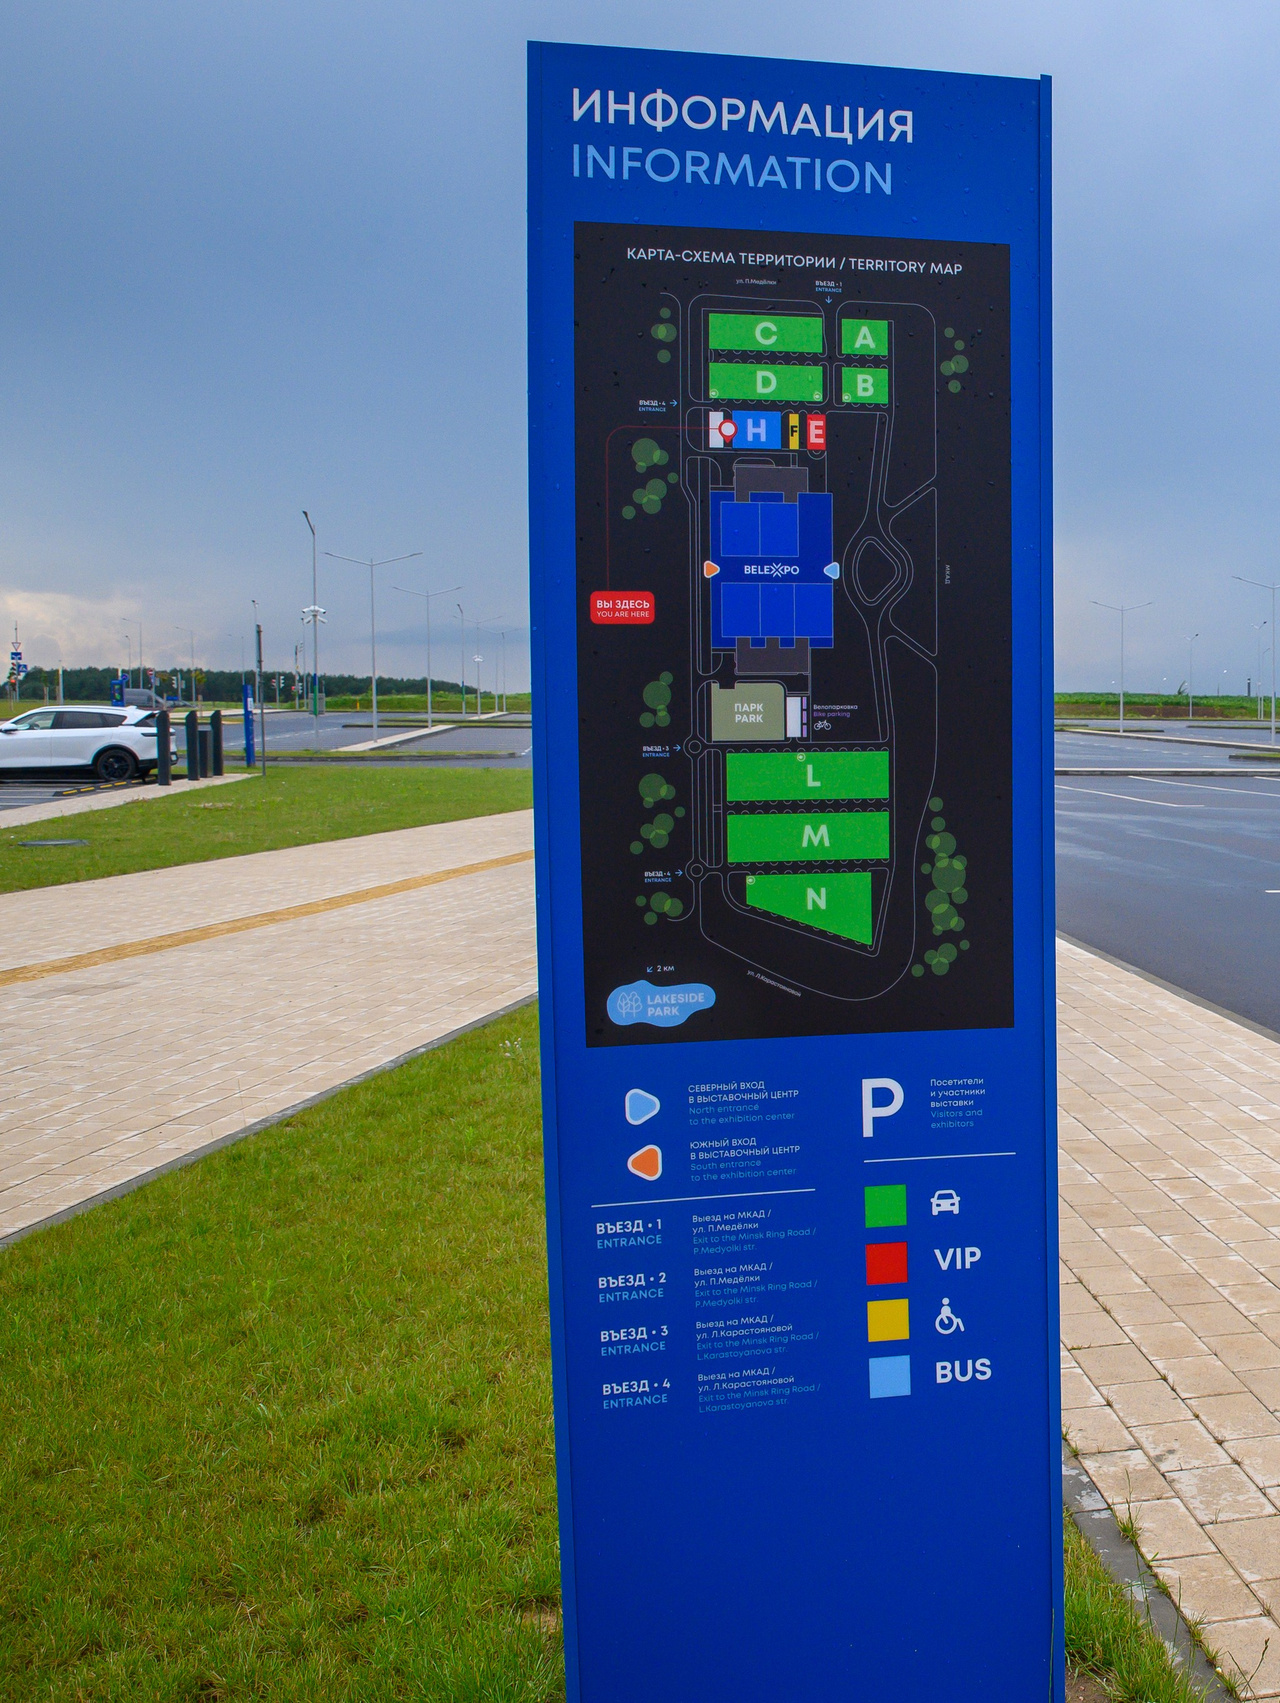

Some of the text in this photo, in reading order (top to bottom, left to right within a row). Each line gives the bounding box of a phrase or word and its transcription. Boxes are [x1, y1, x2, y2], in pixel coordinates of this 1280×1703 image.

[572, 88, 913, 144] ИНФОРМАЦИЯ
[572, 143, 892, 195] INFORMATION
[627, 247, 735, 264] КАРТА-СХЕМА
[739, 252, 836, 269] ТЕРРИТОРИИ
[849, 258, 926, 274] TERRITORY
[930, 262, 963, 275] MAP
[754, 322, 778, 346] C
[854, 325, 876, 349] A
[756, 370, 777, 394] D
[857, 374, 874, 397] B
[747, 419, 766, 442] H
[790, 425, 797, 437] F
[810, 421, 824, 443] E
[596, 600, 650, 609] ВЫ ЗДЕСЬ
[734, 703, 764, 712] ПАРК
[735, 714, 764, 723] PARK
[807, 765, 821, 787] L
[802, 825, 830, 847] M
[807, 887, 826, 910] N
[647, 992, 705, 1005] LAKESIDE
[649, 1006, 679, 1016] PARK
[688, 1081, 765, 1093] СЕВЕРНЫЙ ВХОД
[930, 1078, 984, 1087] Посетители
[688, 1090, 799, 1104] В ВЫСТАВОЧНЫЙ ЦЕНТР
[938, 1088, 986, 1098] участники
[689, 1104, 759, 1115] North entrance
[862, 1077, 904, 1138] P
[930, 1100, 974, 1108] выставки
[689, 1112, 795, 1126] to the exhibition center
[930, 1110, 963, 1118] Visitors
[931, 1120, 974, 1129] exhibitors
[690, 1138, 757, 1149] ЮЖНЫЙ ВХОД
[690, 1145, 800, 1160] В ВЫСТАВОЧНЫЙ ЦЕНТР
[690, 1160, 761, 1171] South entrance
[691, 1168, 796, 1182] to the exhibition center
[692, 1214, 721, 1223] Выезд
[737, 1210, 765, 1219] МКАД
[596, 1219, 661, 1235] ВЪЕЗД 1
[692, 1222, 758, 1235] ул. П.Медёлки
[597, 1234, 662, 1249] ENTRANCE
[693, 1236, 708, 1245] Exit
[710, 1235, 720, 1243] to
[721, 1234, 736, 1242] the
[738, 1232, 764, 1241] Minsk
[766, 1230, 785, 1239] Ring
[787, 1228, 810, 1237] Road
[693, 1244, 741, 1255] P.Medyolki
[933, 1246, 982, 1271] VIP
[694, 1267, 723, 1276] Выезд
[739, 1263, 767, 1272] МКАД
[598, 1272, 666, 1289] ВЪЕЗД 2
[694, 1275, 760, 1288] ул. П.Медёлки
[599, 1288, 664, 1303] ENTRANCE
[695, 1289, 710, 1298] Exit
[712, 1288, 721, 1296] to
[723, 1287, 738, 1295] the
[740, 1285, 766, 1293] Minsk
[767, 1283, 787, 1292] Ring
[789, 1280, 812, 1289] Road
[695, 1297, 743, 1308] P.Medyolki
[696, 1321, 724, 1329] Выезд
[740, 1315, 768, 1325] МКАД
[600, 1325, 668, 1342] ВЪЕЗД 3
[696, 1323, 793, 1341] ул. Л.Карастояновой
[601, 1341, 666, 1356] ENTRANCE
[696, 1342, 712, 1350] Exit
[725, 1339, 740, 1347] the
[741, 1336, 767, 1346] Minsk
[769, 1335, 788, 1344] Ring
[790, 1332, 814, 1341] Road
[697, 1346, 772, 1361] L.Karastoyanova
[698, 1373, 726, 1381] Выезд
[742, 1367, 770, 1377] МКАД
[936, 1357, 992, 1384] BUS
[602, 1378, 670, 1396] ВЪЕЗД 4
[698, 1376, 794, 1393] ул. Л.Карастояновой
[698, 1394, 714, 1402] Exit
[716, 1393, 725, 1401] to
[727, 1392, 742, 1400] the
[743, 1389, 769, 1398] Minsk
[771, 1387, 790, 1395] Ring
[792, 1384, 815, 1393] Road
[603, 1394, 668, 1409] ENTRANCE
[699, 1398, 774, 1413] L.Karastoyanova
